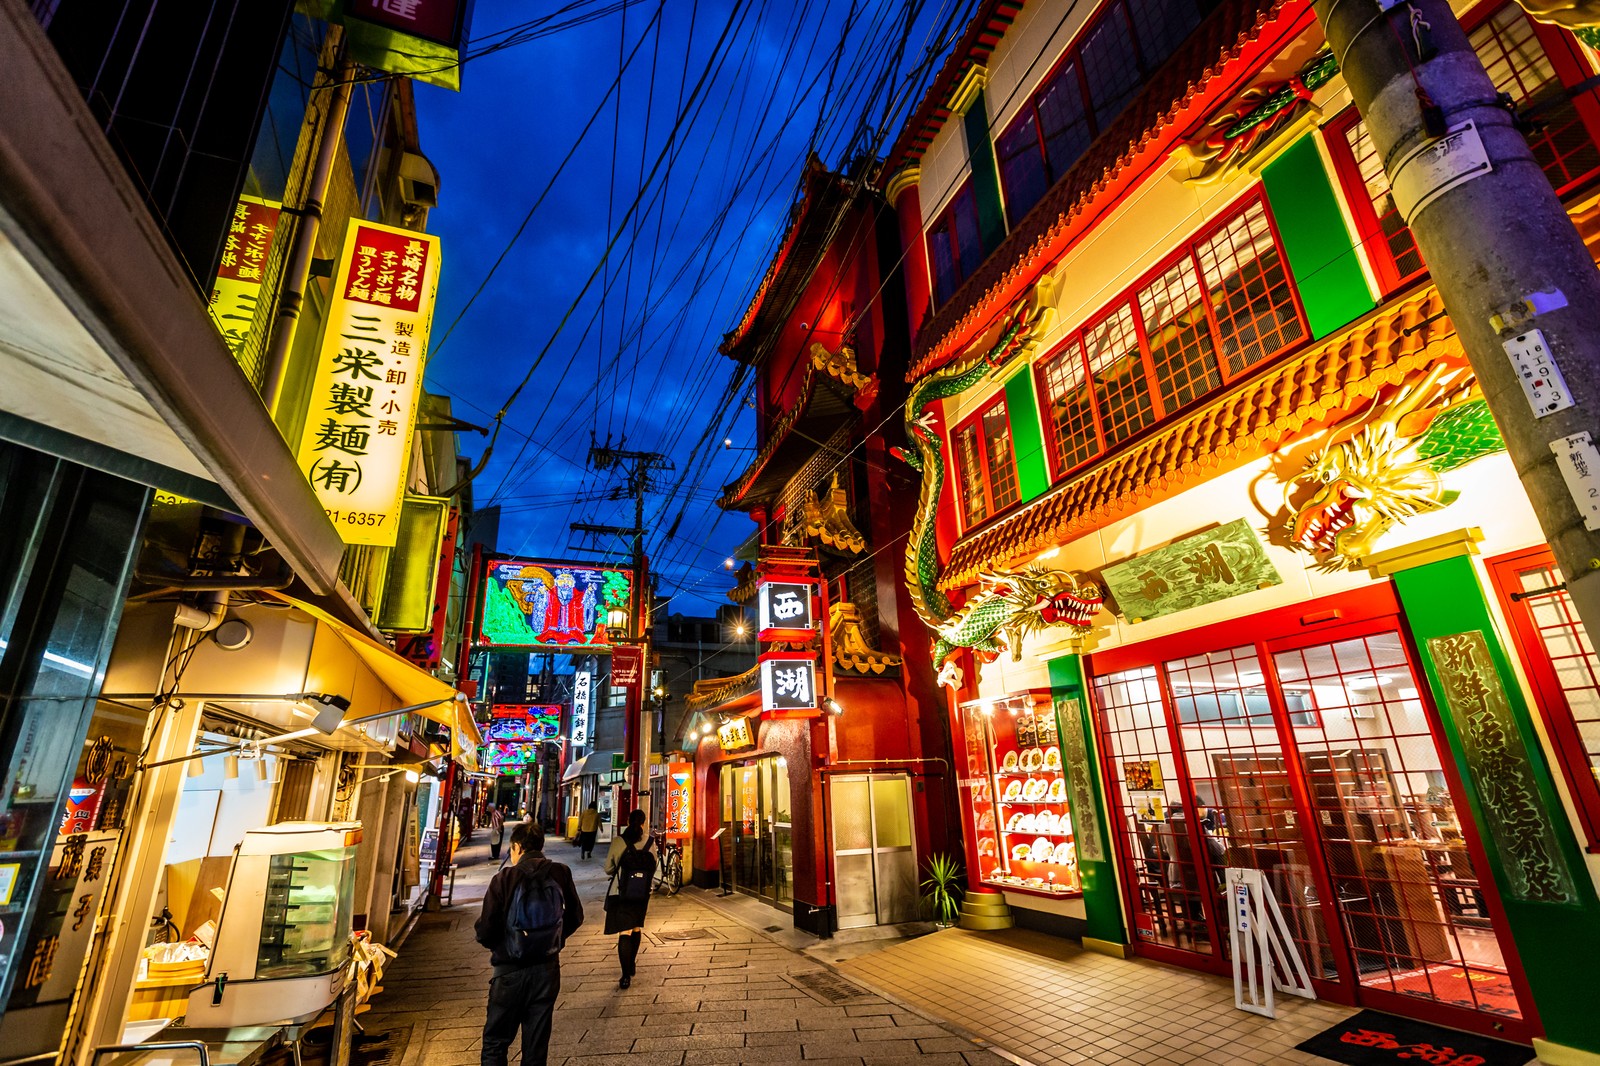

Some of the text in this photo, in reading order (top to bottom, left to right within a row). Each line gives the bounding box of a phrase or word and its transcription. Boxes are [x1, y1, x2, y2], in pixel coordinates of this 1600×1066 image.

[395, 240, 425, 302] 長崎名物
[377, 321, 415, 436] 製造・卸・小売
[1136, 542, 1236, 601] 西湖
